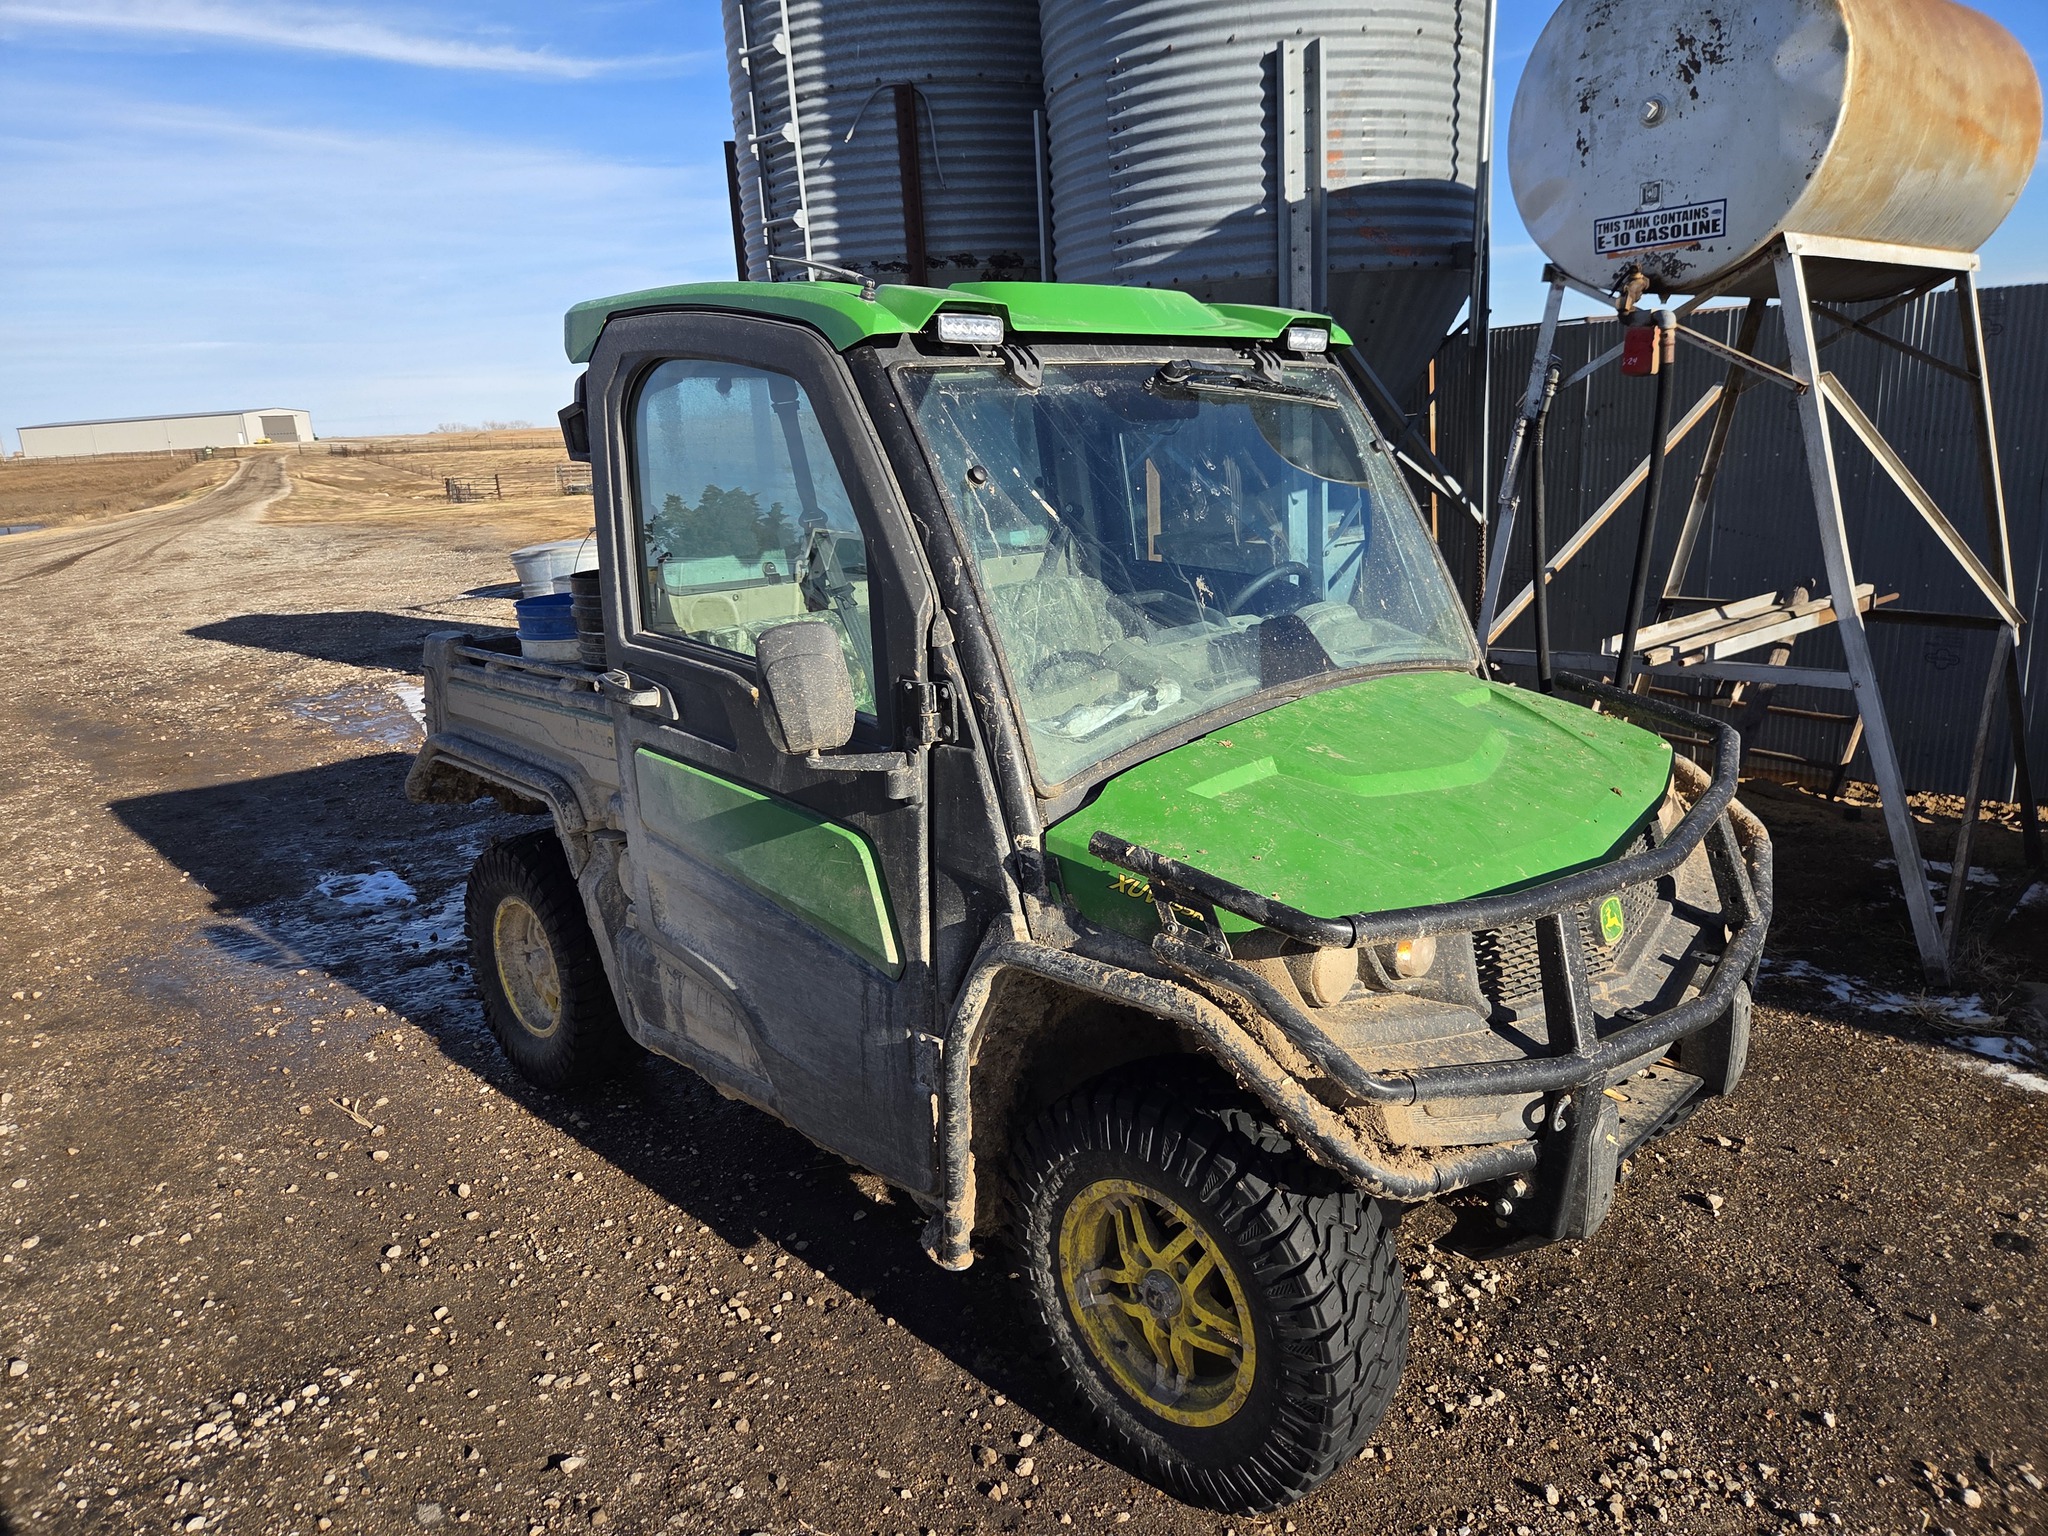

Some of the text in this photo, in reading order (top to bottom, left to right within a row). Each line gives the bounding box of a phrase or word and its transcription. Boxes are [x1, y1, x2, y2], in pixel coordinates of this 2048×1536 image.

[1597, 220, 1621, 235] THIS
[1623, 216, 1650, 231] TANK
[1653, 206, 1709, 226] CONTAINS
[1598, 218, 1721, 249] E-10 GASOLINE
